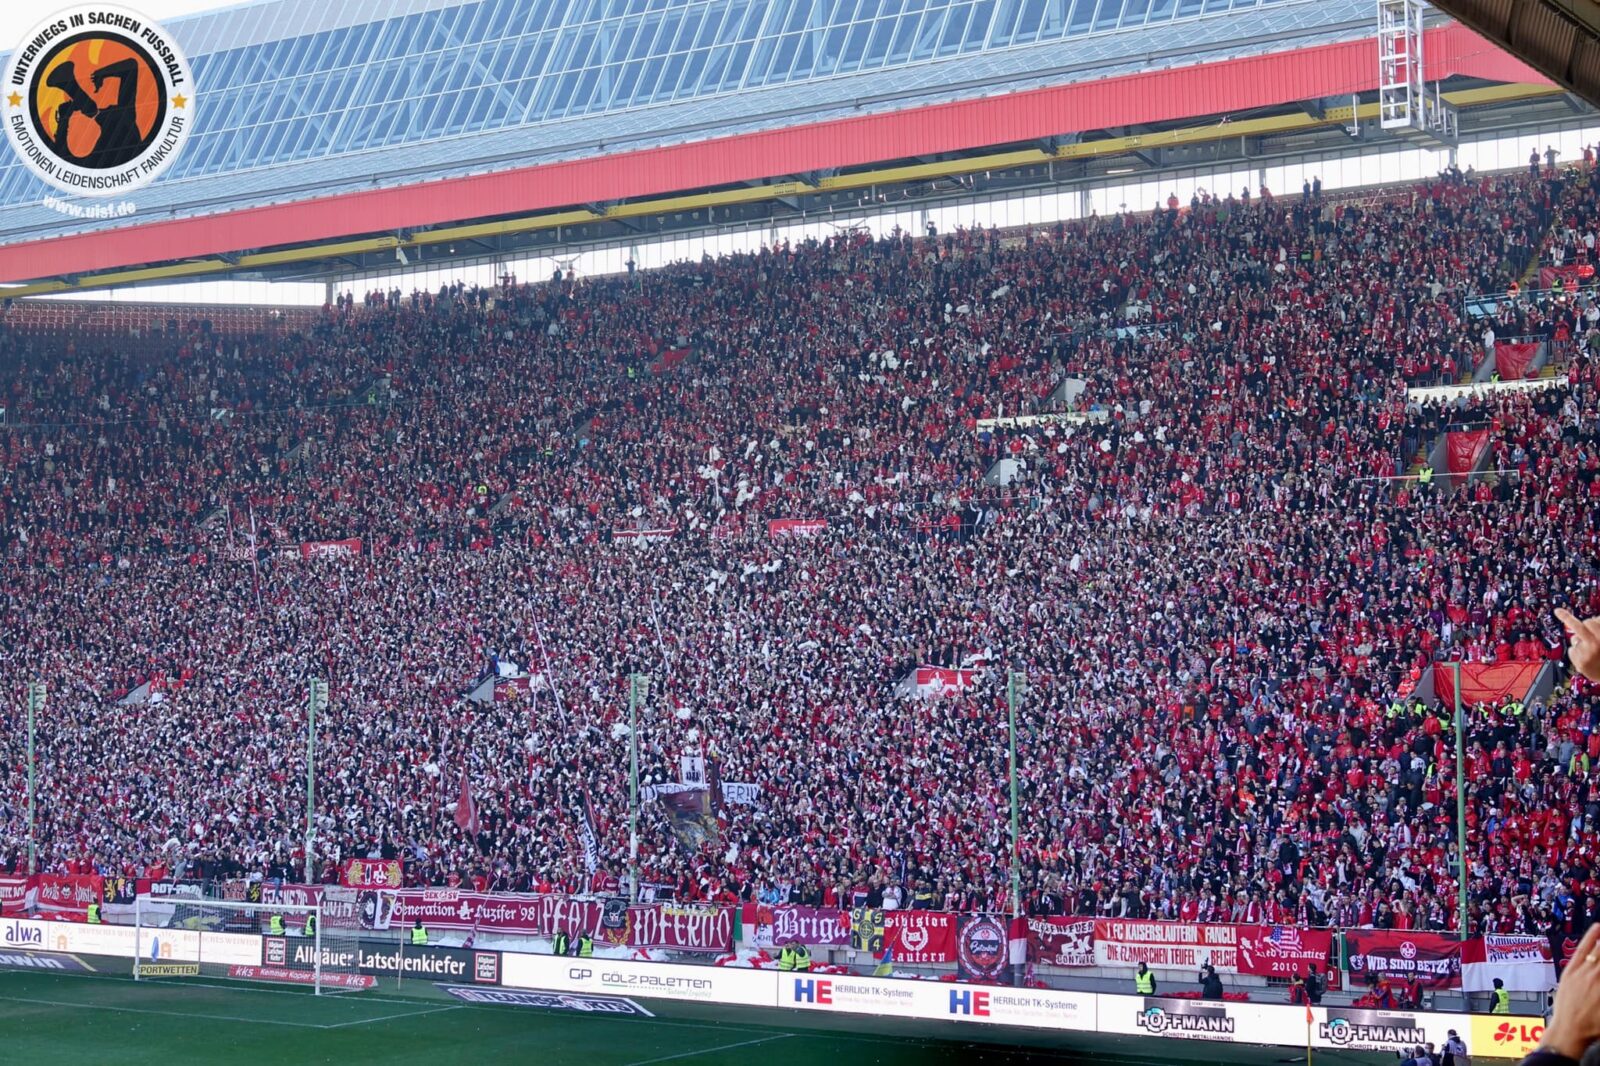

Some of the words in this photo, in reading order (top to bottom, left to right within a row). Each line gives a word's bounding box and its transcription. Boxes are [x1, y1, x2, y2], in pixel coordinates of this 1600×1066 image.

[394, 902, 455, 917] Generation
[474, 904, 516, 923] Luzifer
[542, 896, 605, 941] PFALZ
[6, 921, 42, 943] alwa
[117, 929, 148, 938] WEINOR
[633, 908, 731, 948] INFERNO
[774, 909, 852, 945] Briga
[1125, 923, 1198, 943] KAISERSLAUTERN
[1205, 927, 1237, 944] FANCLU
[183, 933, 223, 943] DEUSCHES
[294, 945, 353, 969] Allgäuer
[359, 950, 465, 975] Latschenkiefer
[892, 951, 945, 962] autern
[1211, 950, 1237, 967] BELGIE
[1272, 962, 1298, 972] 2010
[1366, 955, 1388, 970] WIR
[1390, 958, 1415, 970] SIND
[1417, 958, 1450, 974] BETZE
[311, 973, 340, 982] Ssteme
[569, 968, 592, 980] GP
[602, 971, 637, 984] GÖLZ
[795, 978, 832, 1004] HE
[835, 984, 870, 994] HERRLICH
[871, 987, 913, 999] TK-Systeme
[949, 989, 990, 1016] HE
[993, 996, 1030, 1006] HERRLICH
[1033, 999, 1078, 1011] TK-Systeme
[1137, 1007, 1235, 1033] HOFFMANN
[1320, 1018, 1425, 1045] HOFFMANN
